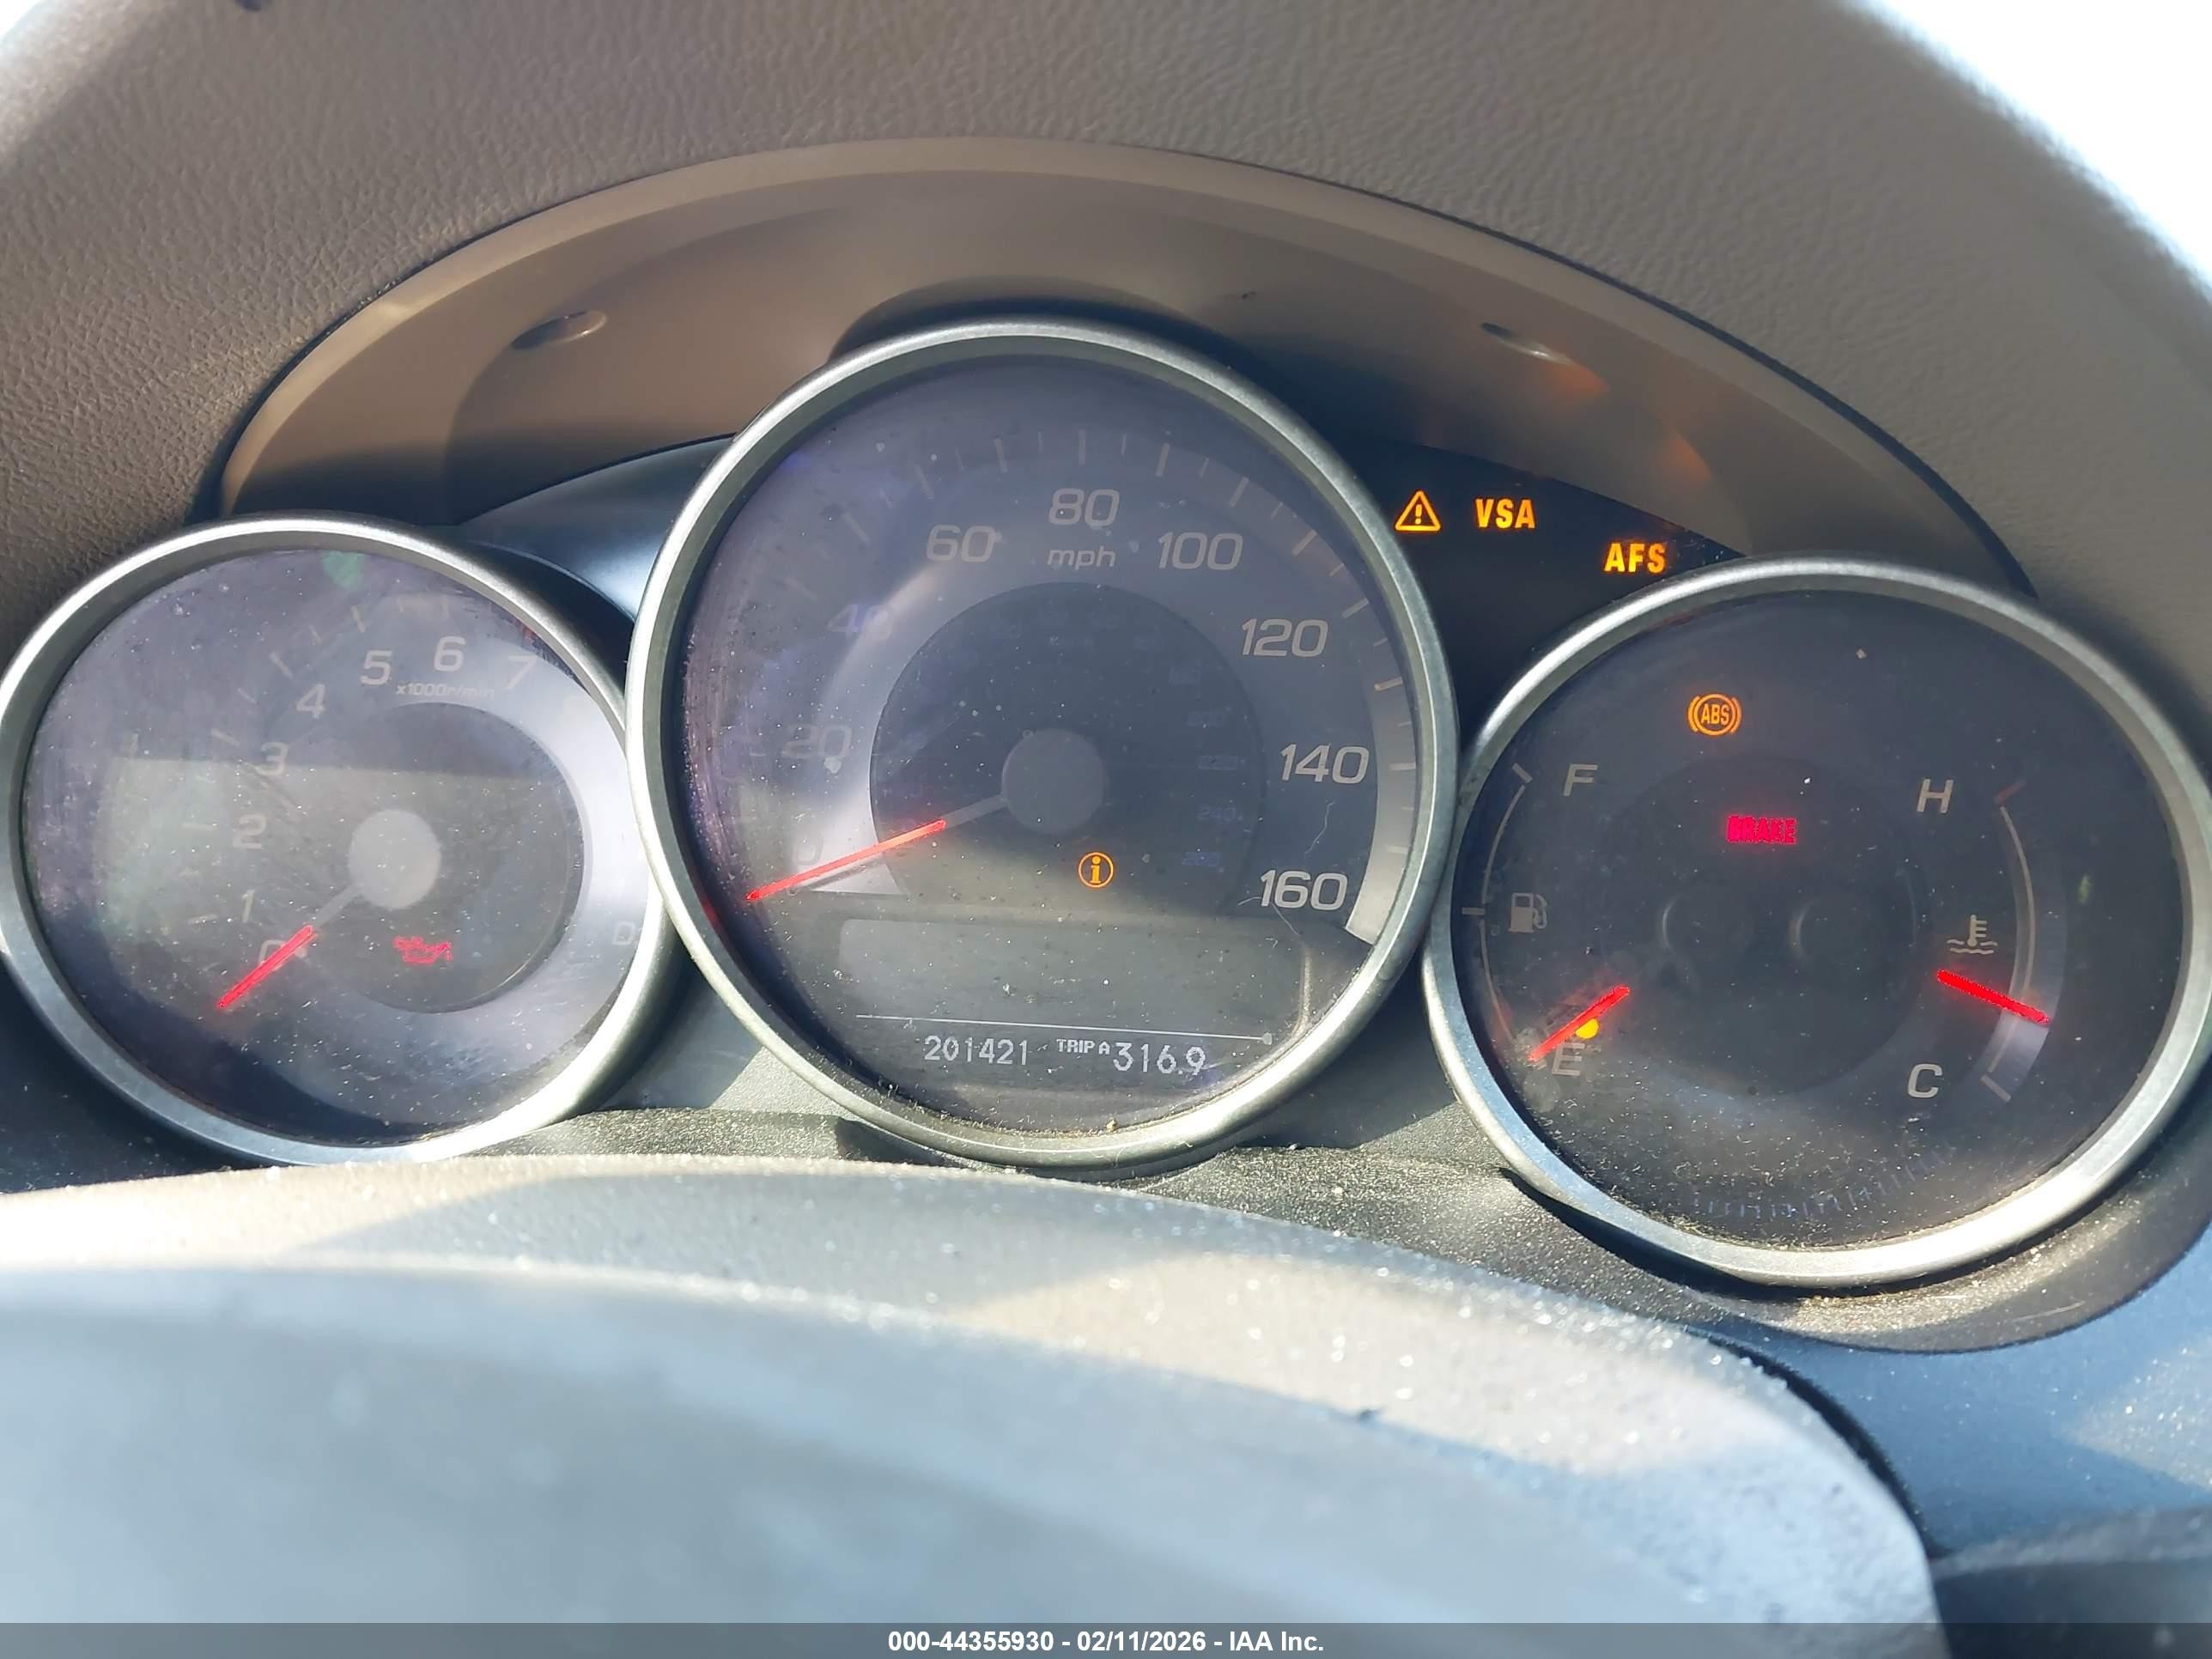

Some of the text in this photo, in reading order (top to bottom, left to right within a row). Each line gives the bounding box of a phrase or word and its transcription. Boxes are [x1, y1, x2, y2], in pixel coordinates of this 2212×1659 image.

[1048, 488, 1121, 528] 80
[1474, 498, 1536, 530] VSA
[926, 526, 996, 563] 60
[1046, 546, 1116, 570] mph
[1158, 532, 1245, 572] 100
[1604, 543, 1667, 574] AFS
[826, 604, 891, 639] 40
[1241, 619, 1329, 658] 120
[359, 649, 392, 686] 5
[433, 636, 466, 672] 6
[503, 655, 538, 690] 7
[295, 683, 327, 720] 4
[1701, 703, 1729, 726] ABS
[258, 742, 289, 775] 3
[781, 725, 853, 759] 20
[1280, 744, 1370, 785] 140
[1563, 763, 1599, 797] F
[1917, 778, 1954, 813] H
[232, 813, 267, 850] 2
[1727, 815, 1797, 845] BRAKE
[241, 889, 255, 924] 1
[1260, 868, 1349, 910] 160
[924, 1035, 1207, 1076] 201421 TRIP A 316.9
[1551, 1042, 1587, 1076] E
[1907, 1063, 1943, 1099] C
